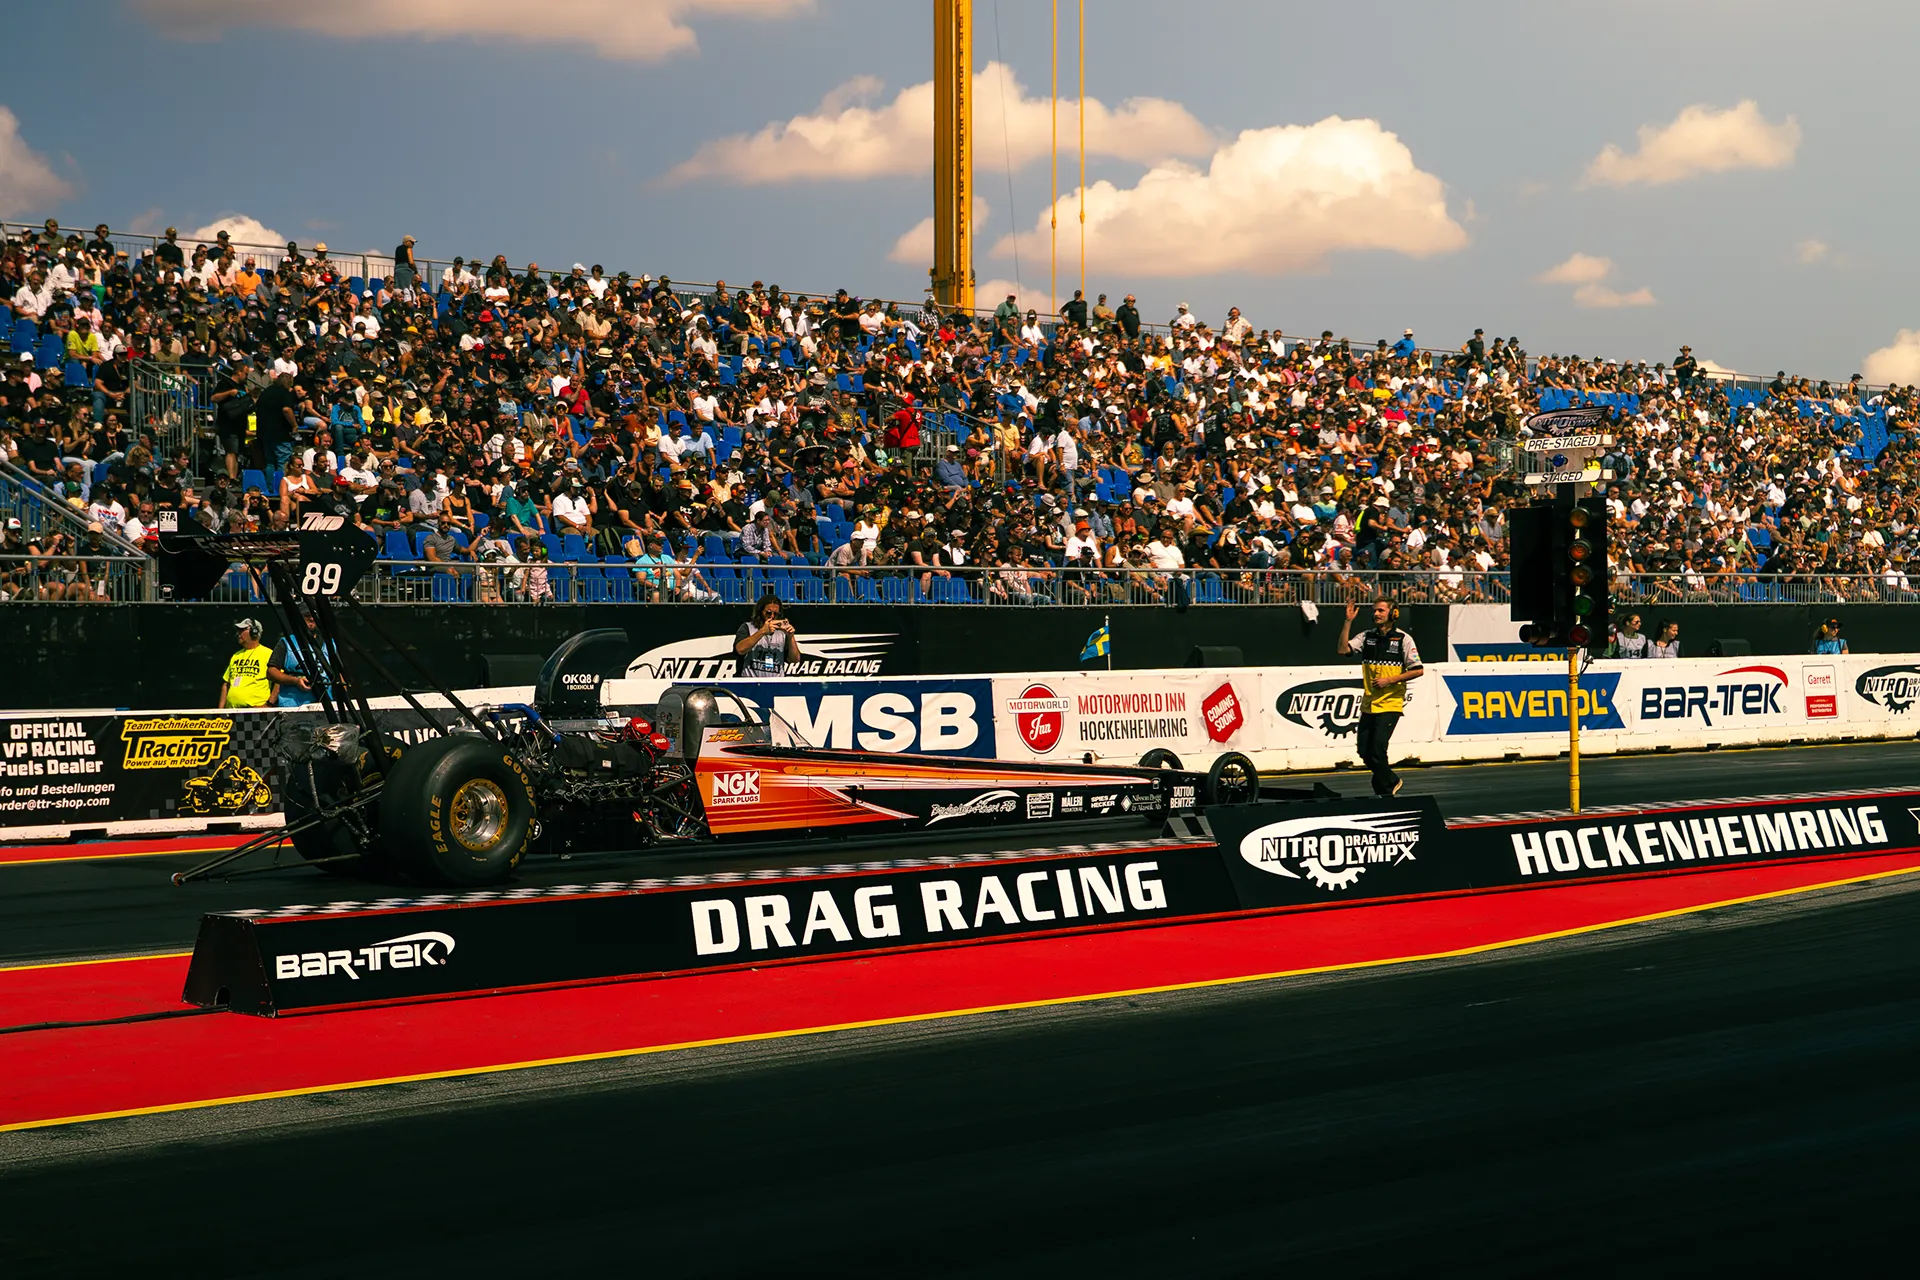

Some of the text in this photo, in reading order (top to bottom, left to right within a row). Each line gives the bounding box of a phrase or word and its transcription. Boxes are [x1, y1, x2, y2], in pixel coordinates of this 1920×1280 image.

[1528, 436, 1597, 450] PRE-STAGED
[1541, 471, 1583, 483] STAGED
[301, 562, 342, 595] 89
[232, 659, 260, 667] MEDIA
[823, 659, 882, 674] RACING
[1807, 674, 1831, 685] Garrett
[1009, 700, 1069, 710] MOTORWORLD
[1077, 692, 1186, 715] MOTORWORLD INN
[1206, 694, 1235, 723] COMING
[10, 722, 87, 739] OFFICIAL
[126, 720, 231, 730] TeamTechnikerRacing
[1029, 714, 1052, 741] Inn
[1079, 717, 1188, 741] HOCKENHEIMRING
[1214, 710, 1237, 733] SOON!
[3, 740, 96, 758] VP RACING
[0, 758, 104, 776] Fuels Dealer
[0, 783, 116, 797] fo und Bestellungen
[713, 771, 759, 796] NGK
[1173, 786, 1195, 797] TATTOO
[430, 795, 449, 853] EAGLE
[1345, 831, 1419, 846] DRAG RACING
[1511, 805, 1888, 876] HOCKENHEIMRING
[1261, 834, 1417, 867] NITROLYMPX
[689, 861, 1167, 955] DRAG RACING
